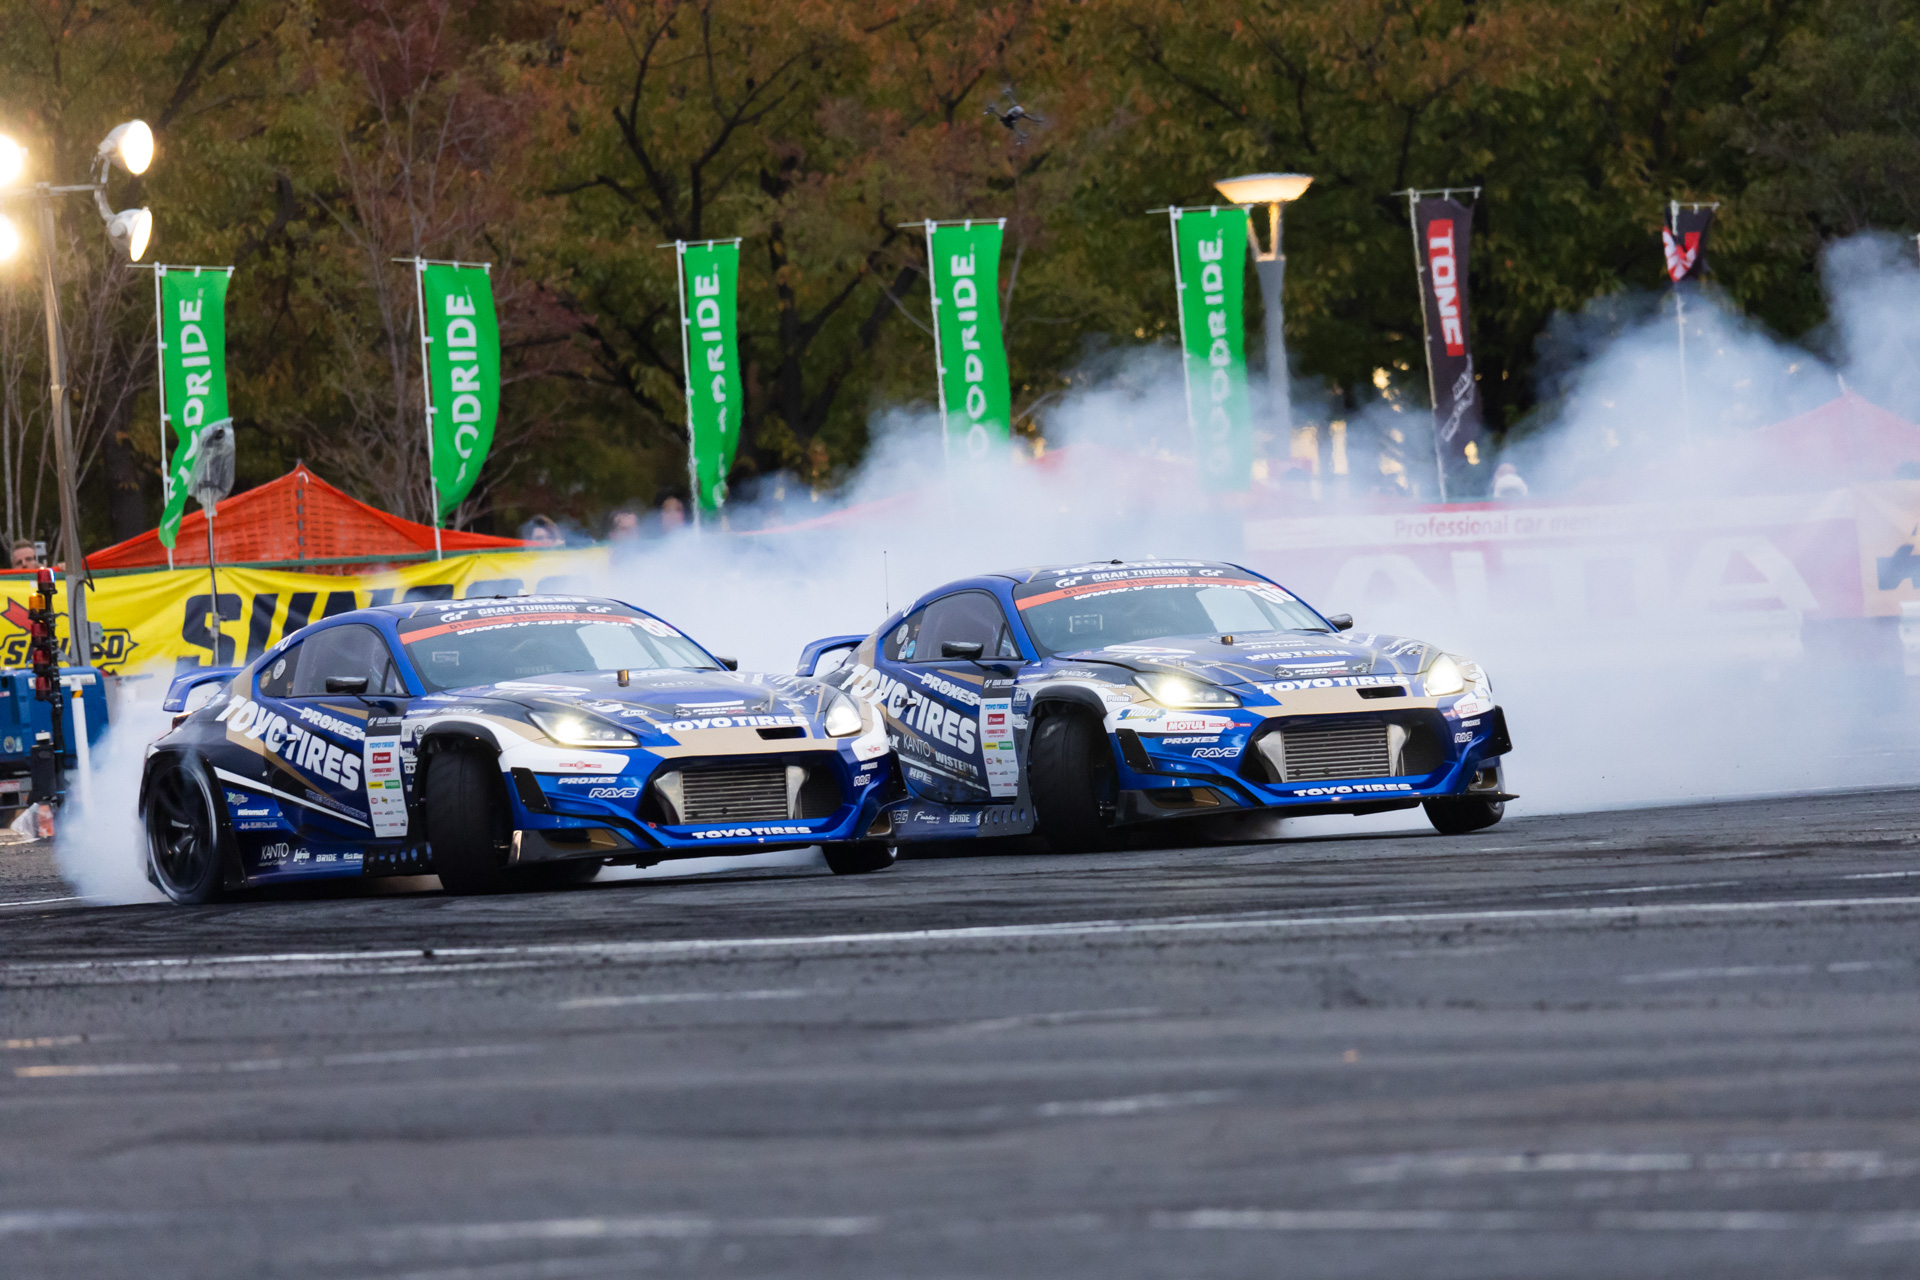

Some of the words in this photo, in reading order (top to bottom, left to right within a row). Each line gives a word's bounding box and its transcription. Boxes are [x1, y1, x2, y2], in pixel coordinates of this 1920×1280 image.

[1429, 228, 1464, 345] TONE
[950, 253, 989, 459] OODRIDE
[1394, 515, 1508, 539] Professional
[1513, 516, 1543, 535] car
[1092, 571, 1129, 580] GRAN
[1131, 568, 1188, 576] TURISMO
[1245, 582, 1297, 604] 66
[478, 606, 515, 615] GRAN
[921, 672, 980, 706] PROXES
[1257, 679, 1340, 695] TOYO
[1334, 676, 1410, 686] TIRES
[839, 663, 909, 719] TOYO
[906, 689, 977, 755] TIRES
[300, 706, 362, 741] PROXES
[655, 717, 737, 734] TOYO
[734, 715, 809, 726] TIRES
[1168, 721, 1205, 730] MOTUL
[215, 694, 287, 753] TOYO
[285, 723, 362, 791] TIRES
[904, 734, 931, 757] KANTO
[1162, 736, 1220, 745] PROXES
[1192, 747, 1241, 758] RAYS
[558, 776, 618, 784] PROXES
[588, 788, 639, 798] RAYS
[1293, 786, 1352, 797] TOYO
[1352, 783, 1412, 792] TIRES
[949, 814, 970, 823] BRIDE
[692, 827, 752, 839] TOYO
[751, 826, 812, 834] TIRES
[261, 842, 290, 861] KANTO
[315, 853, 338, 862] BRIDE
